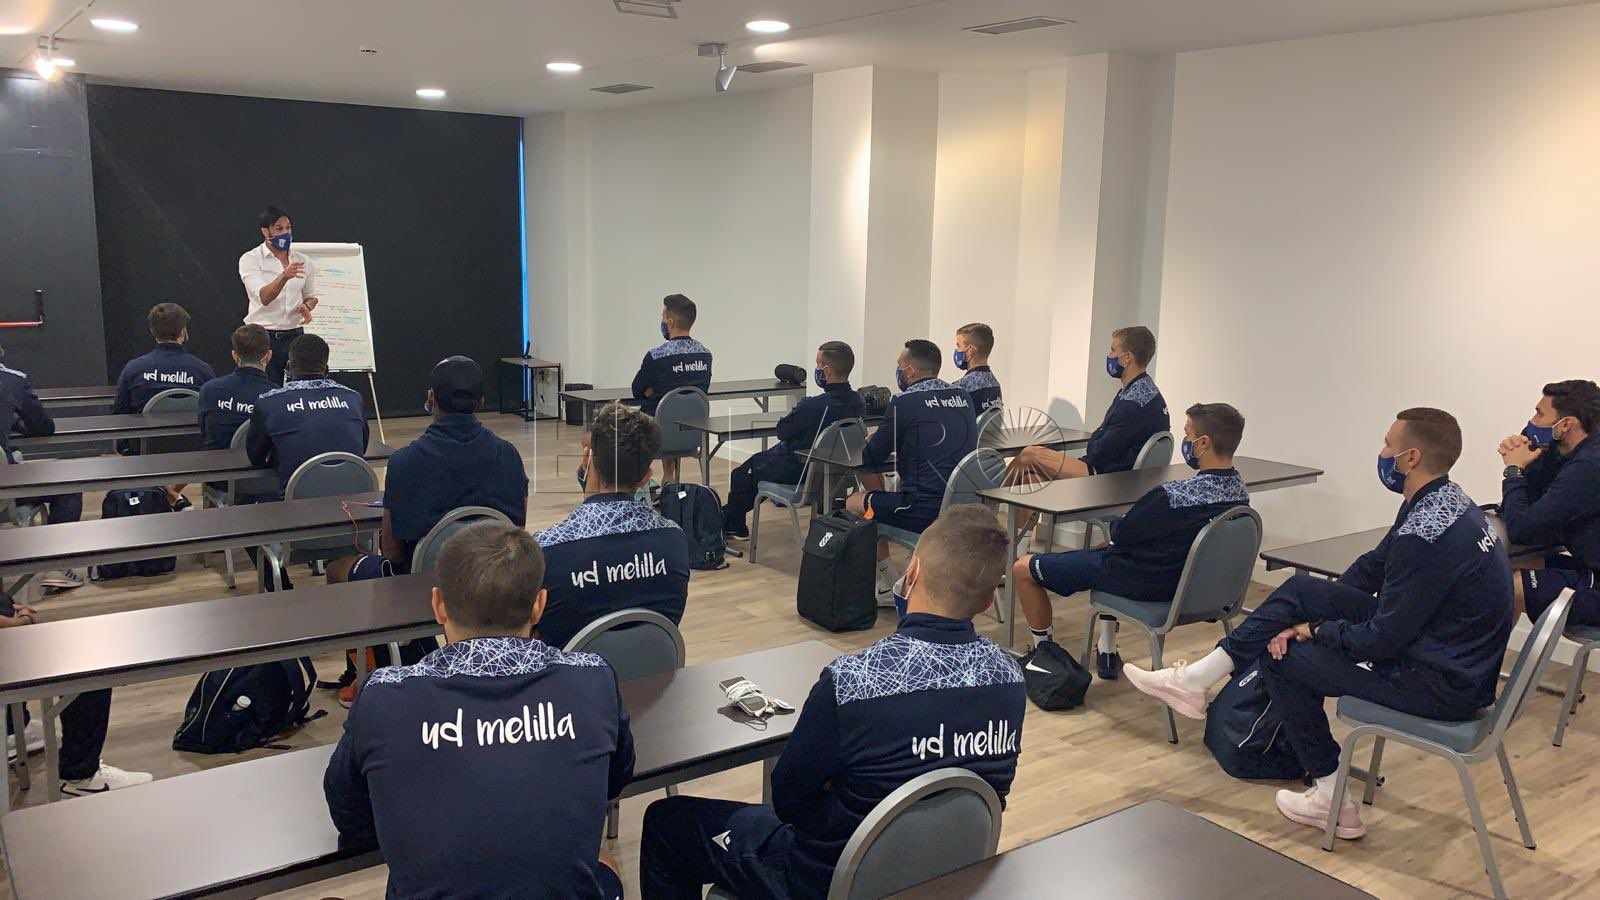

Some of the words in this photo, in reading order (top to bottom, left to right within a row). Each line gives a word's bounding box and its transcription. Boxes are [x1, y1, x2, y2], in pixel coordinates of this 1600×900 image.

[672, 361, 684, 373] ud
[684, 360, 707, 372] melilla
[143, 369, 158, 381] ud
[160, 371, 194, 384] melilla
[217, 397, 234, 411] ud
[286, 398, 305, 413] ud
[308, 396, 350, 410] melilla
[924, 395, 940, 408] ud
[940, 395, 970, 409] melilla
[571, 560, 600, 589] ud
[605, 551, 667, 583] melilla
[421, 708, 463, 750] ud
[476, 701, 577, 747] melilla
[911, 722, 944, 760] ud
[953, 719, 1017, 758] melilla
